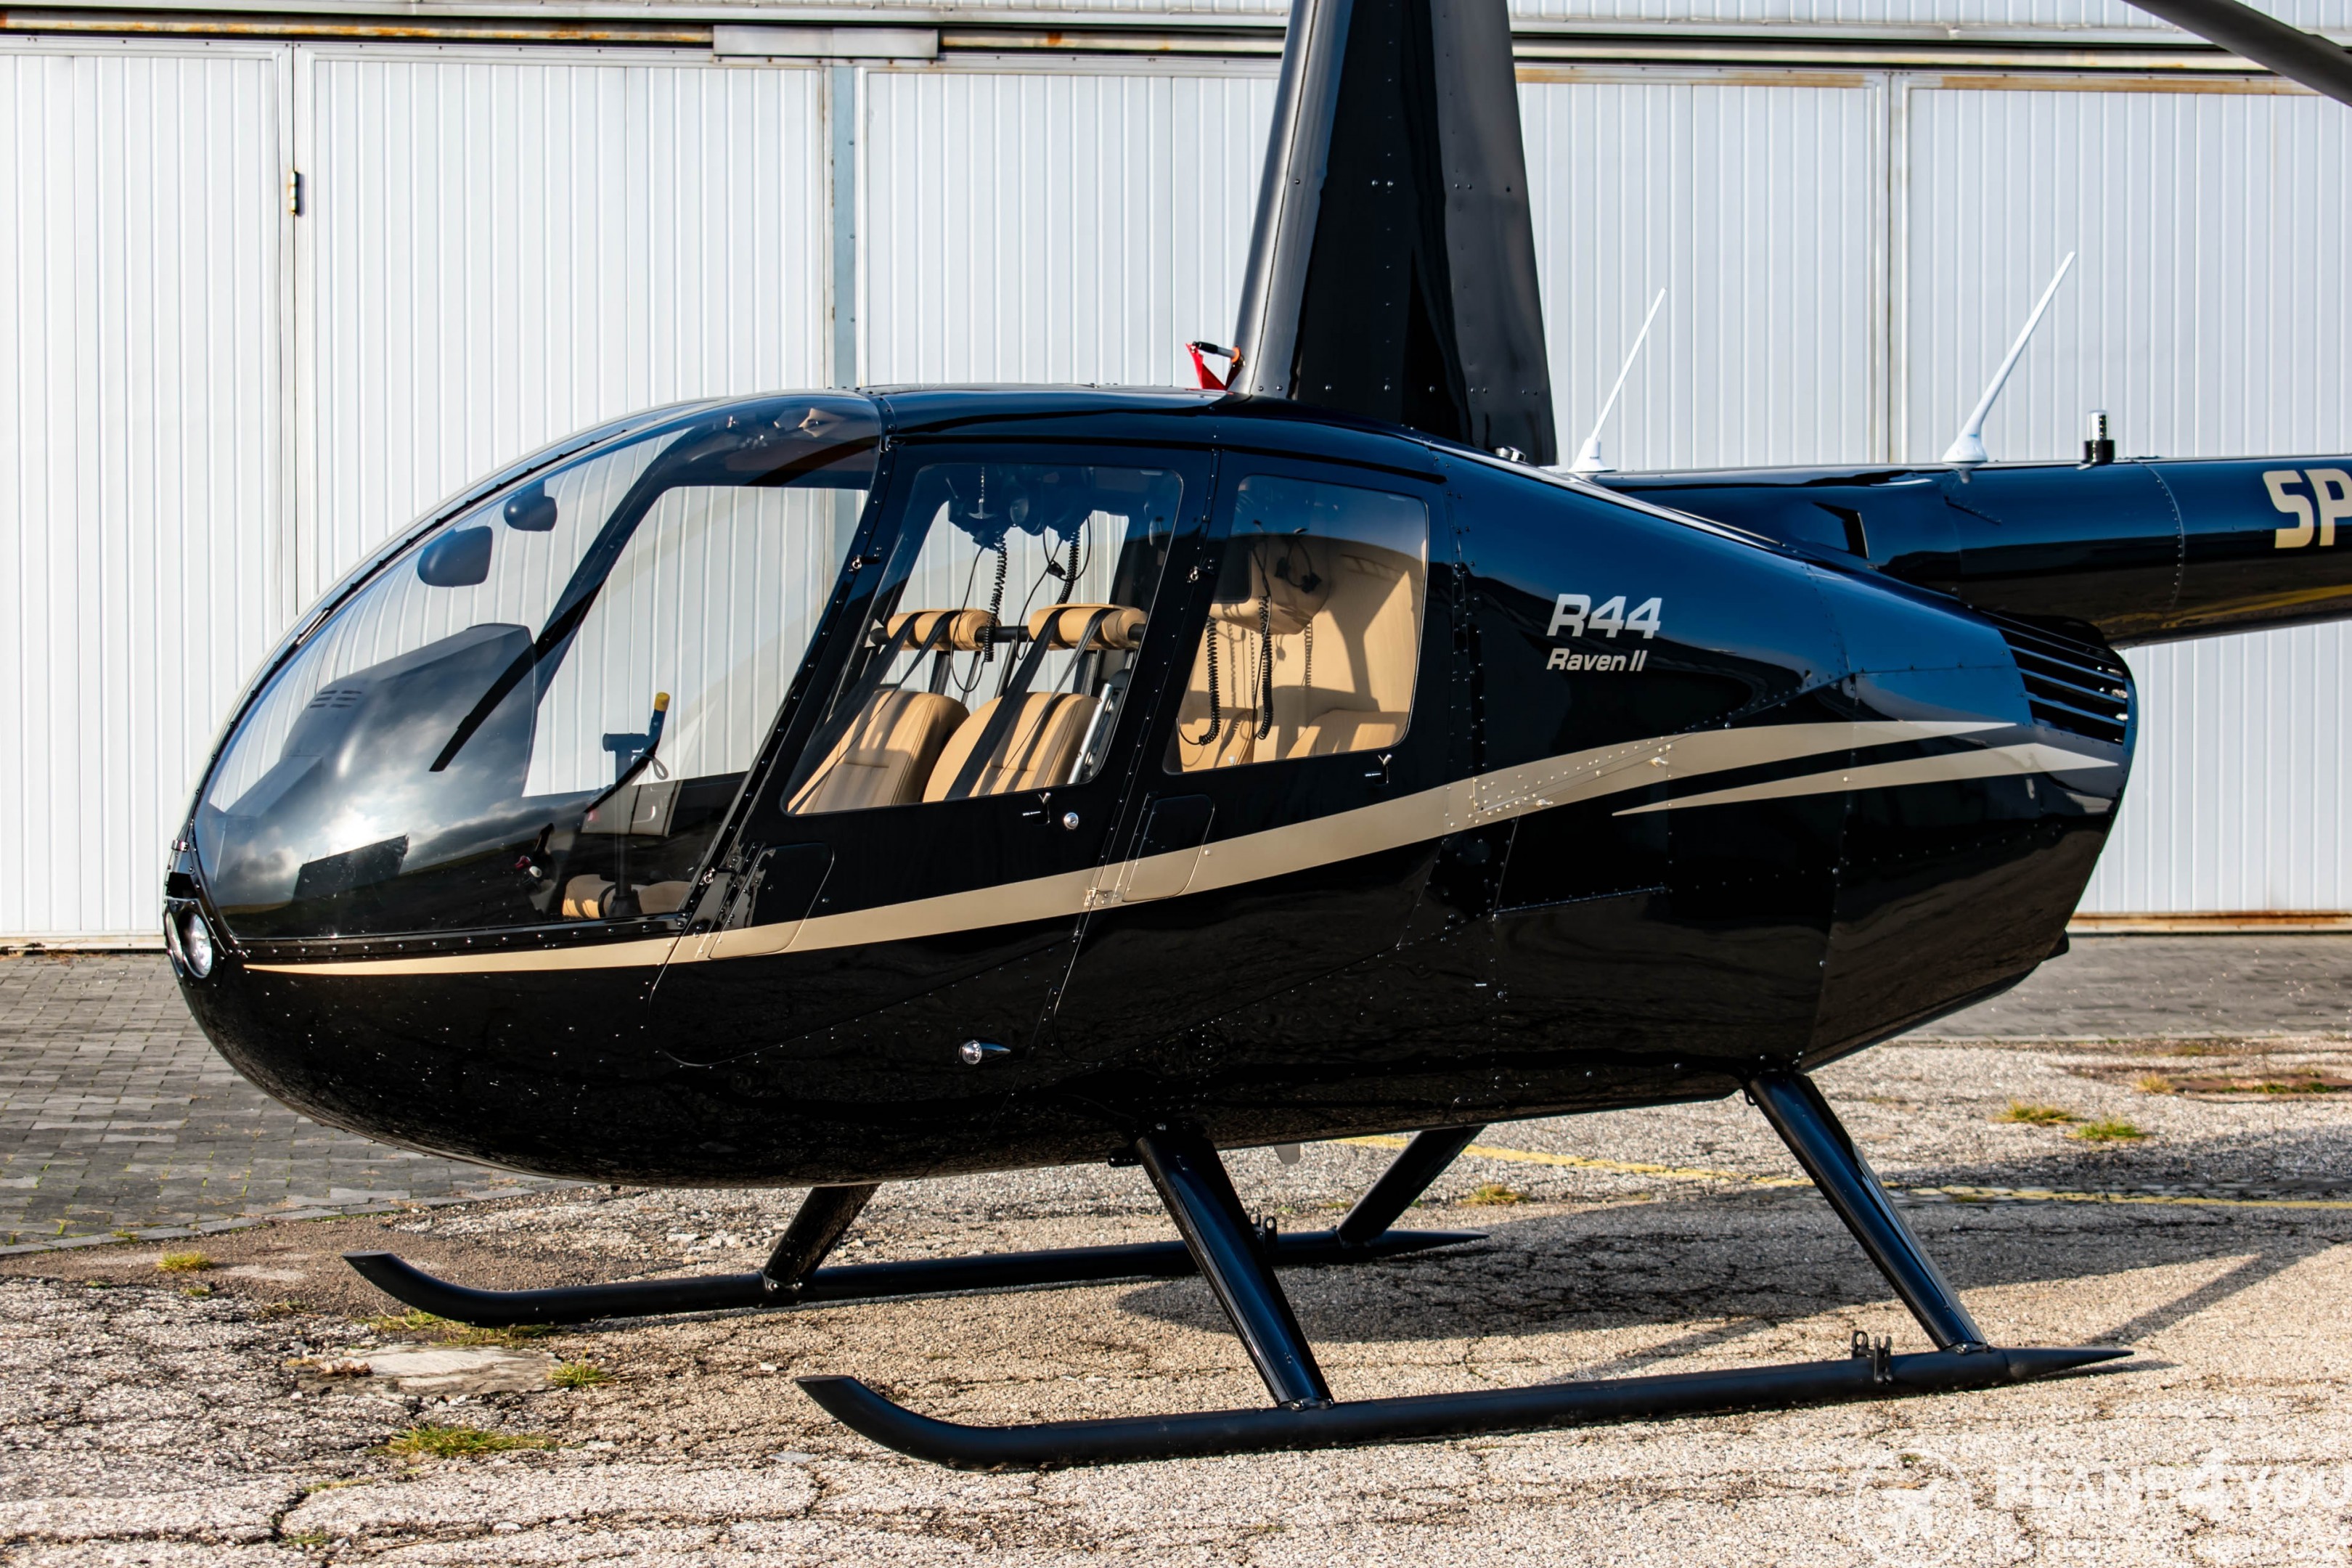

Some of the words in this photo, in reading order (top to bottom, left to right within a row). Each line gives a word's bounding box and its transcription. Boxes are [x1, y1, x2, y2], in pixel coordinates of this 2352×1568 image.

[2262, 468, 2352, 549] SP
[1546, 593, 1662, 640] R44
[1546, 648, 1627, 671] Raven
[1629, 650, 1648, 671] II
